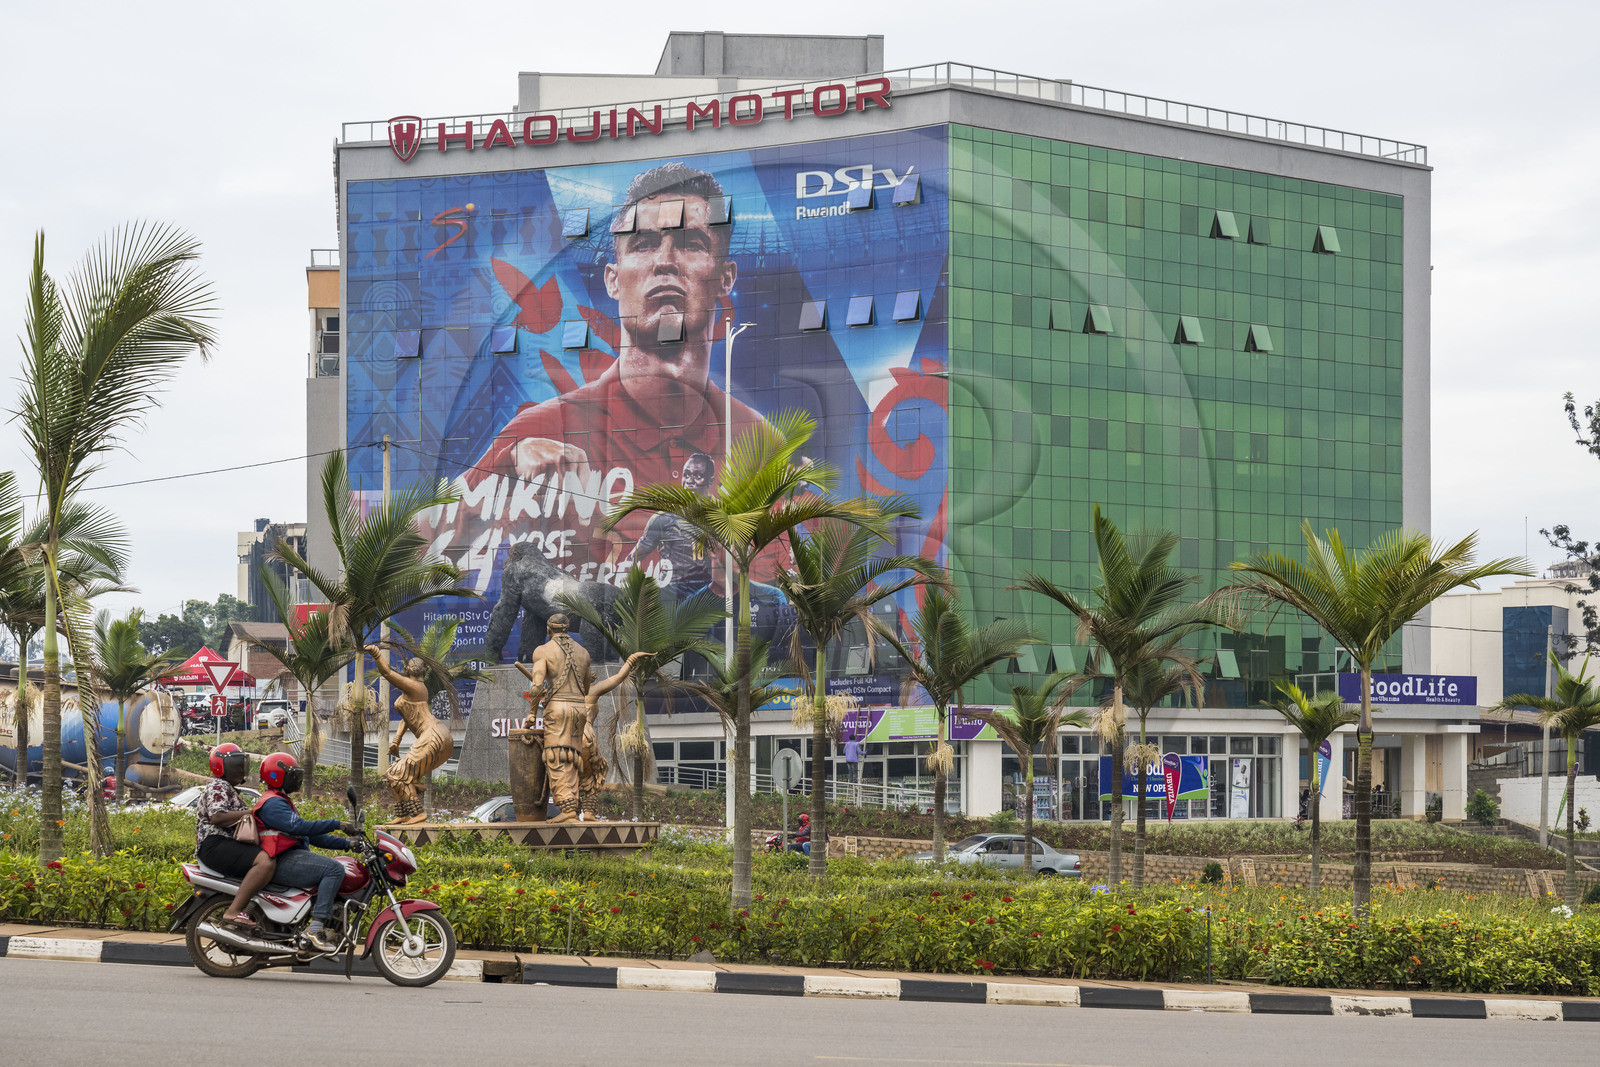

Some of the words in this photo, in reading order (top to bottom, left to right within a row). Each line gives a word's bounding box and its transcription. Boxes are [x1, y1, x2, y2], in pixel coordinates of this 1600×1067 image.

[438, 104, 663, 152] HAOJIN
[686, 76, 892, 131] MOTOR
[423, 611, 457, 621] Hitamo
[460, 611, 481, 621] DStv
[830, 677, 853, 686] Includes
[867, 685, 892, 695] Compact
[1132, 784, 1152, 793] NW
[1152, 784, 1166, 793] OPE
[1166, 773, 1176, 804] UBWIZA
